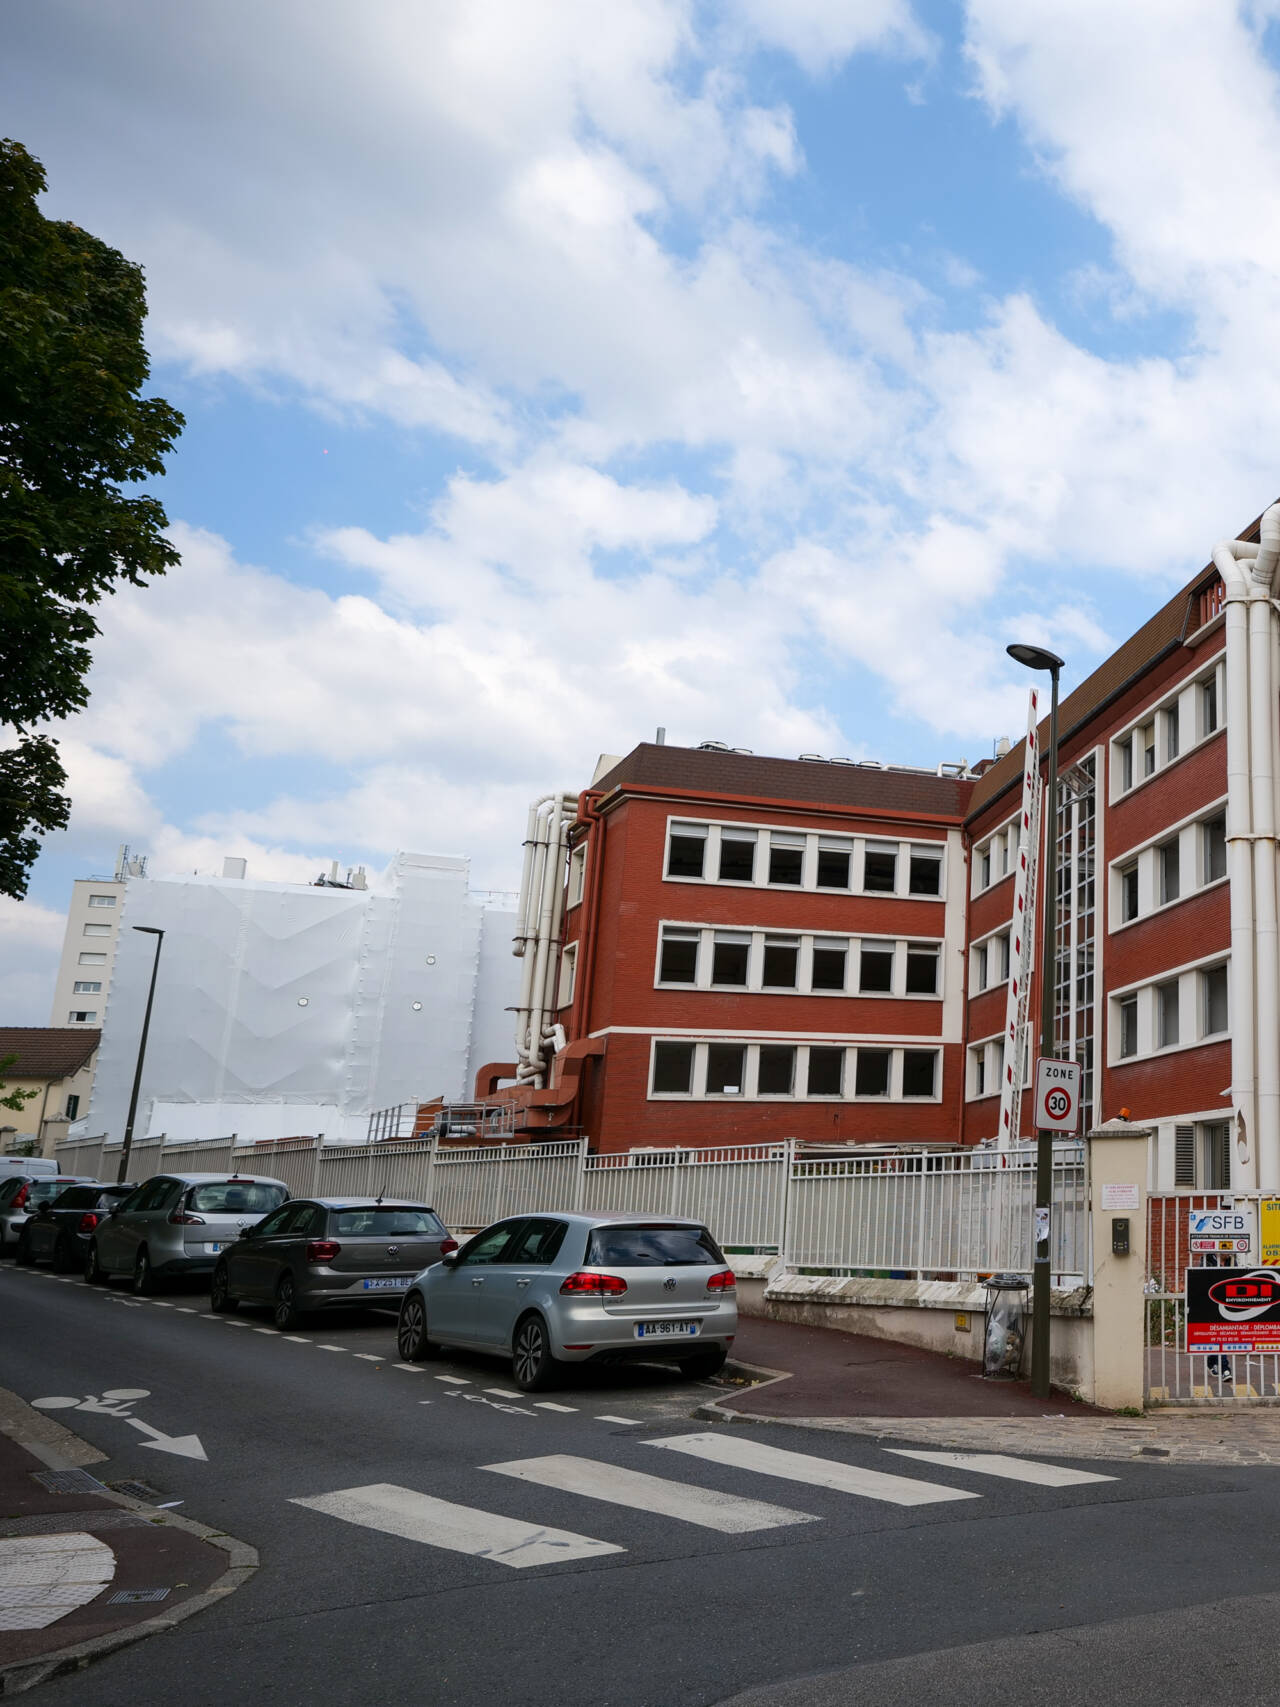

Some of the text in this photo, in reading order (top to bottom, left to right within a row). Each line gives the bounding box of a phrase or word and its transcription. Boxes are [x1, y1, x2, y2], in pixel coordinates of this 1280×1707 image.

[1046, 1067, 1074, 1080] ZONE
[1050, 1096, 1066, 1111] 30
[1211, 1215, 1244, 1230] SFB
[1225, 1284, 1272, 1297] DI
